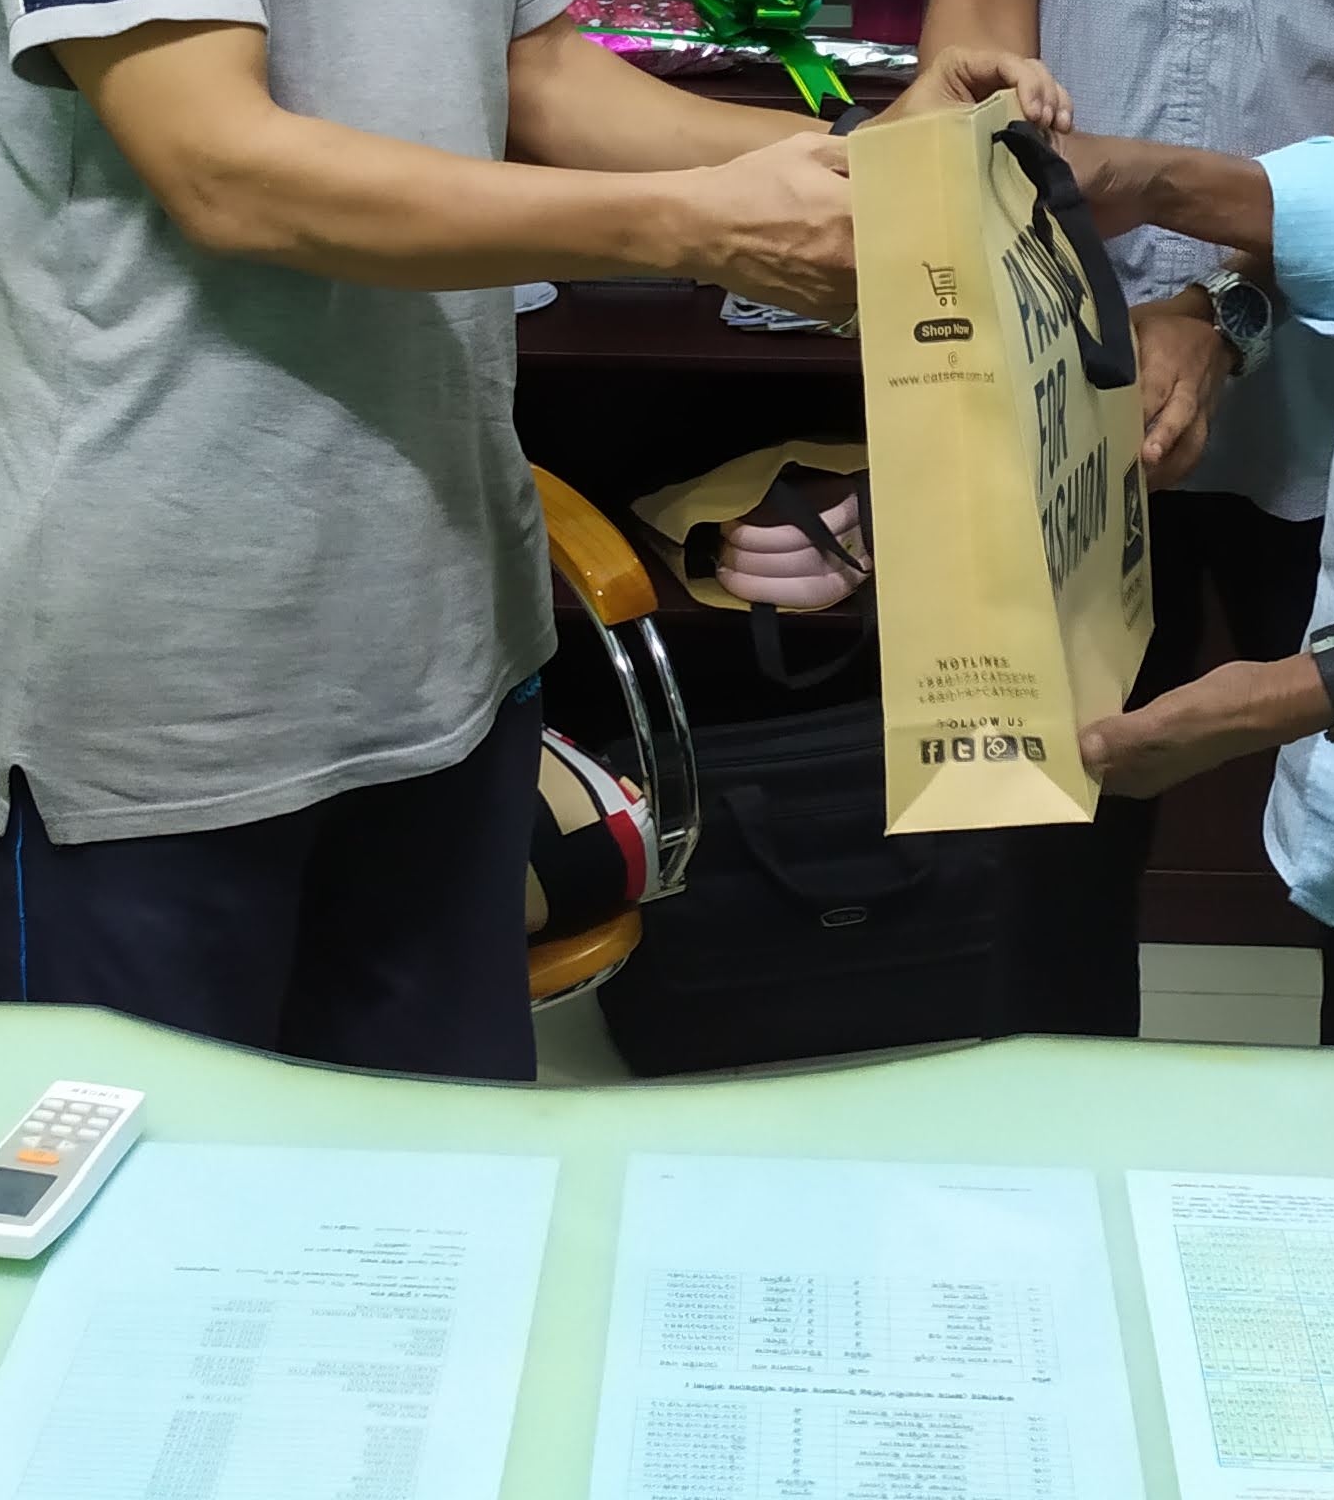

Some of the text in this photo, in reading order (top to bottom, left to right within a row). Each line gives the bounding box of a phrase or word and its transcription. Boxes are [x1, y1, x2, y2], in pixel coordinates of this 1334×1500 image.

[921, 322, 971, 339] Shop Now
[1034, 357, 1068, 495] FOR
[1007, 716, 1026, 728] US
